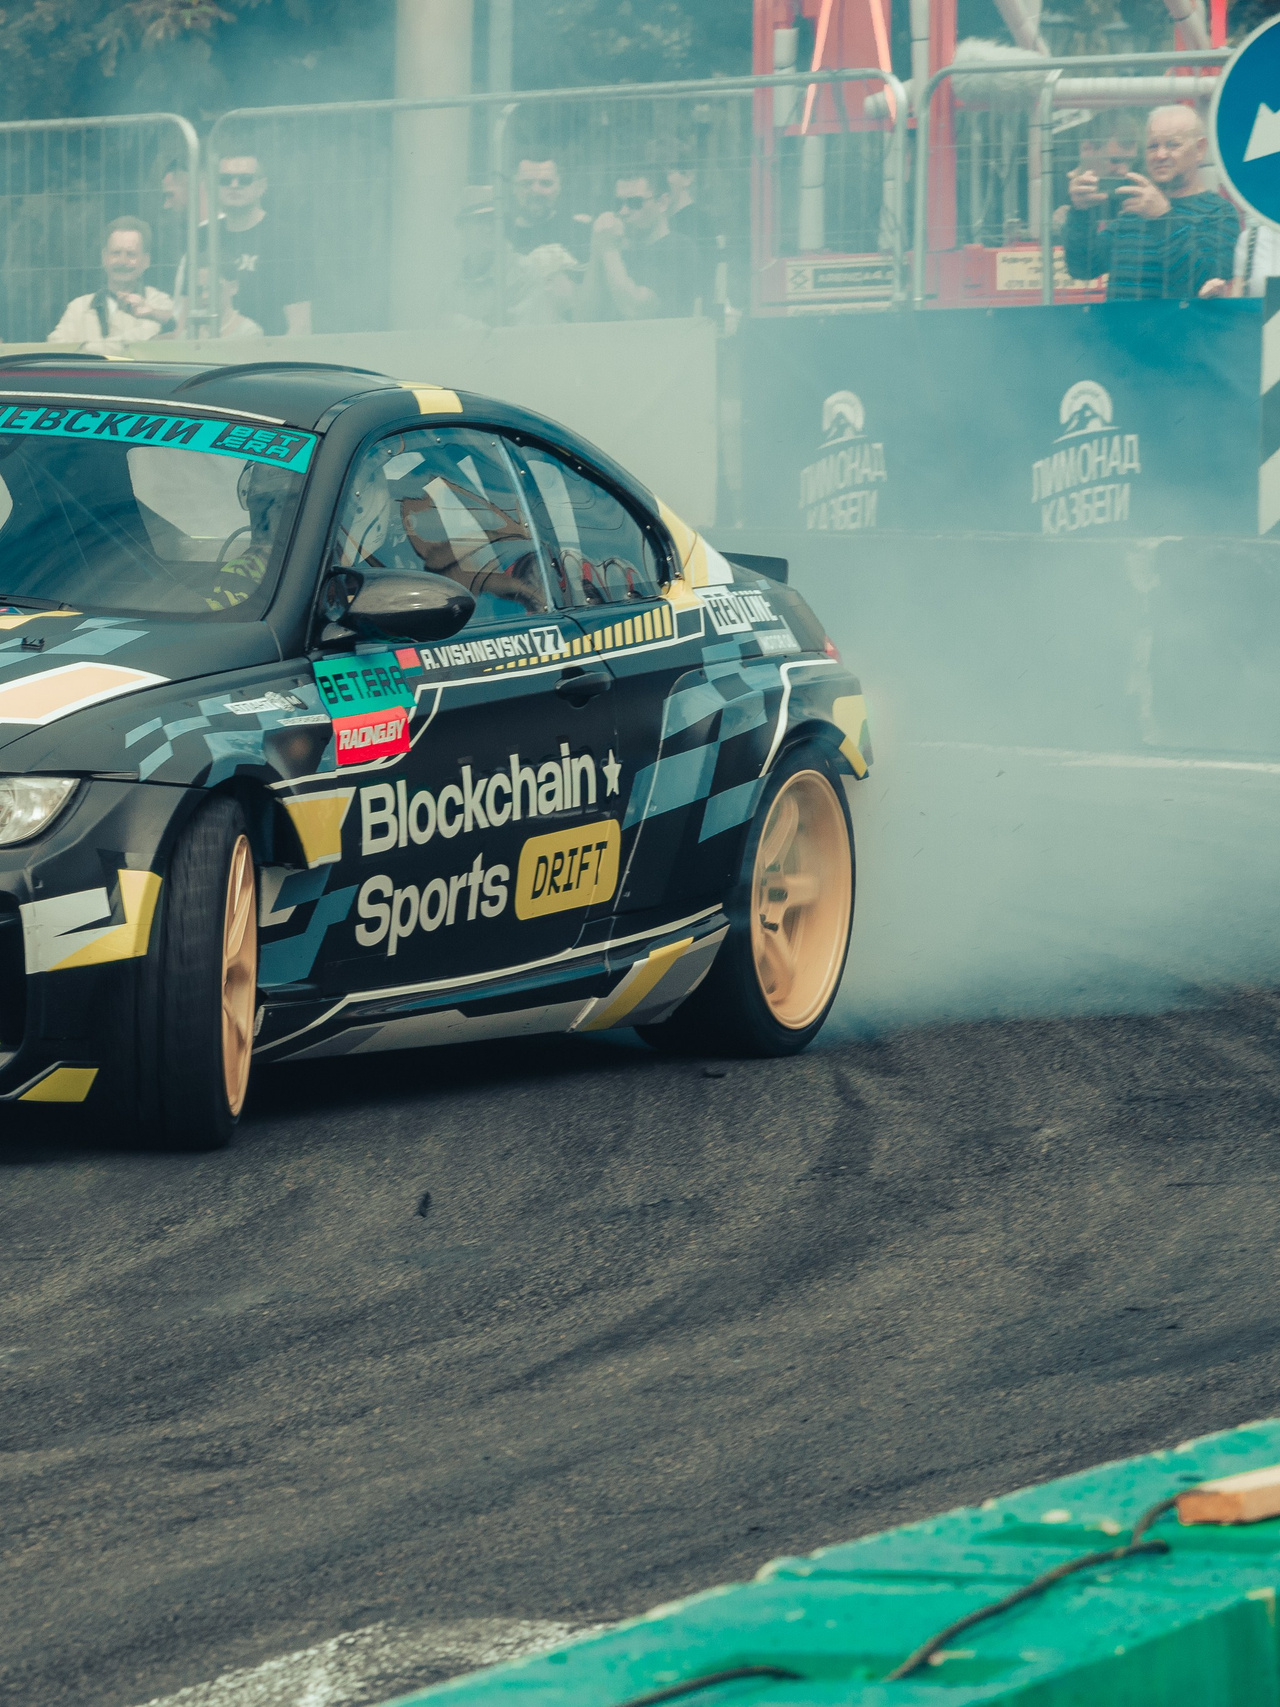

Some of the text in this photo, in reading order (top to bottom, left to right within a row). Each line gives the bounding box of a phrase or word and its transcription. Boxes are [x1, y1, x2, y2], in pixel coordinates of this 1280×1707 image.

[230, 425, 301, 446] BET
[1031, 434, 1141, 503] ЛИМОНАД
[1042, 483, 1131, 534] КАЗБЕГИ
[533, 628, 560, 653] 77
[360, 743, 597, 857] Blockchain
[355, 841, 608, 956] Sports DRIFT
